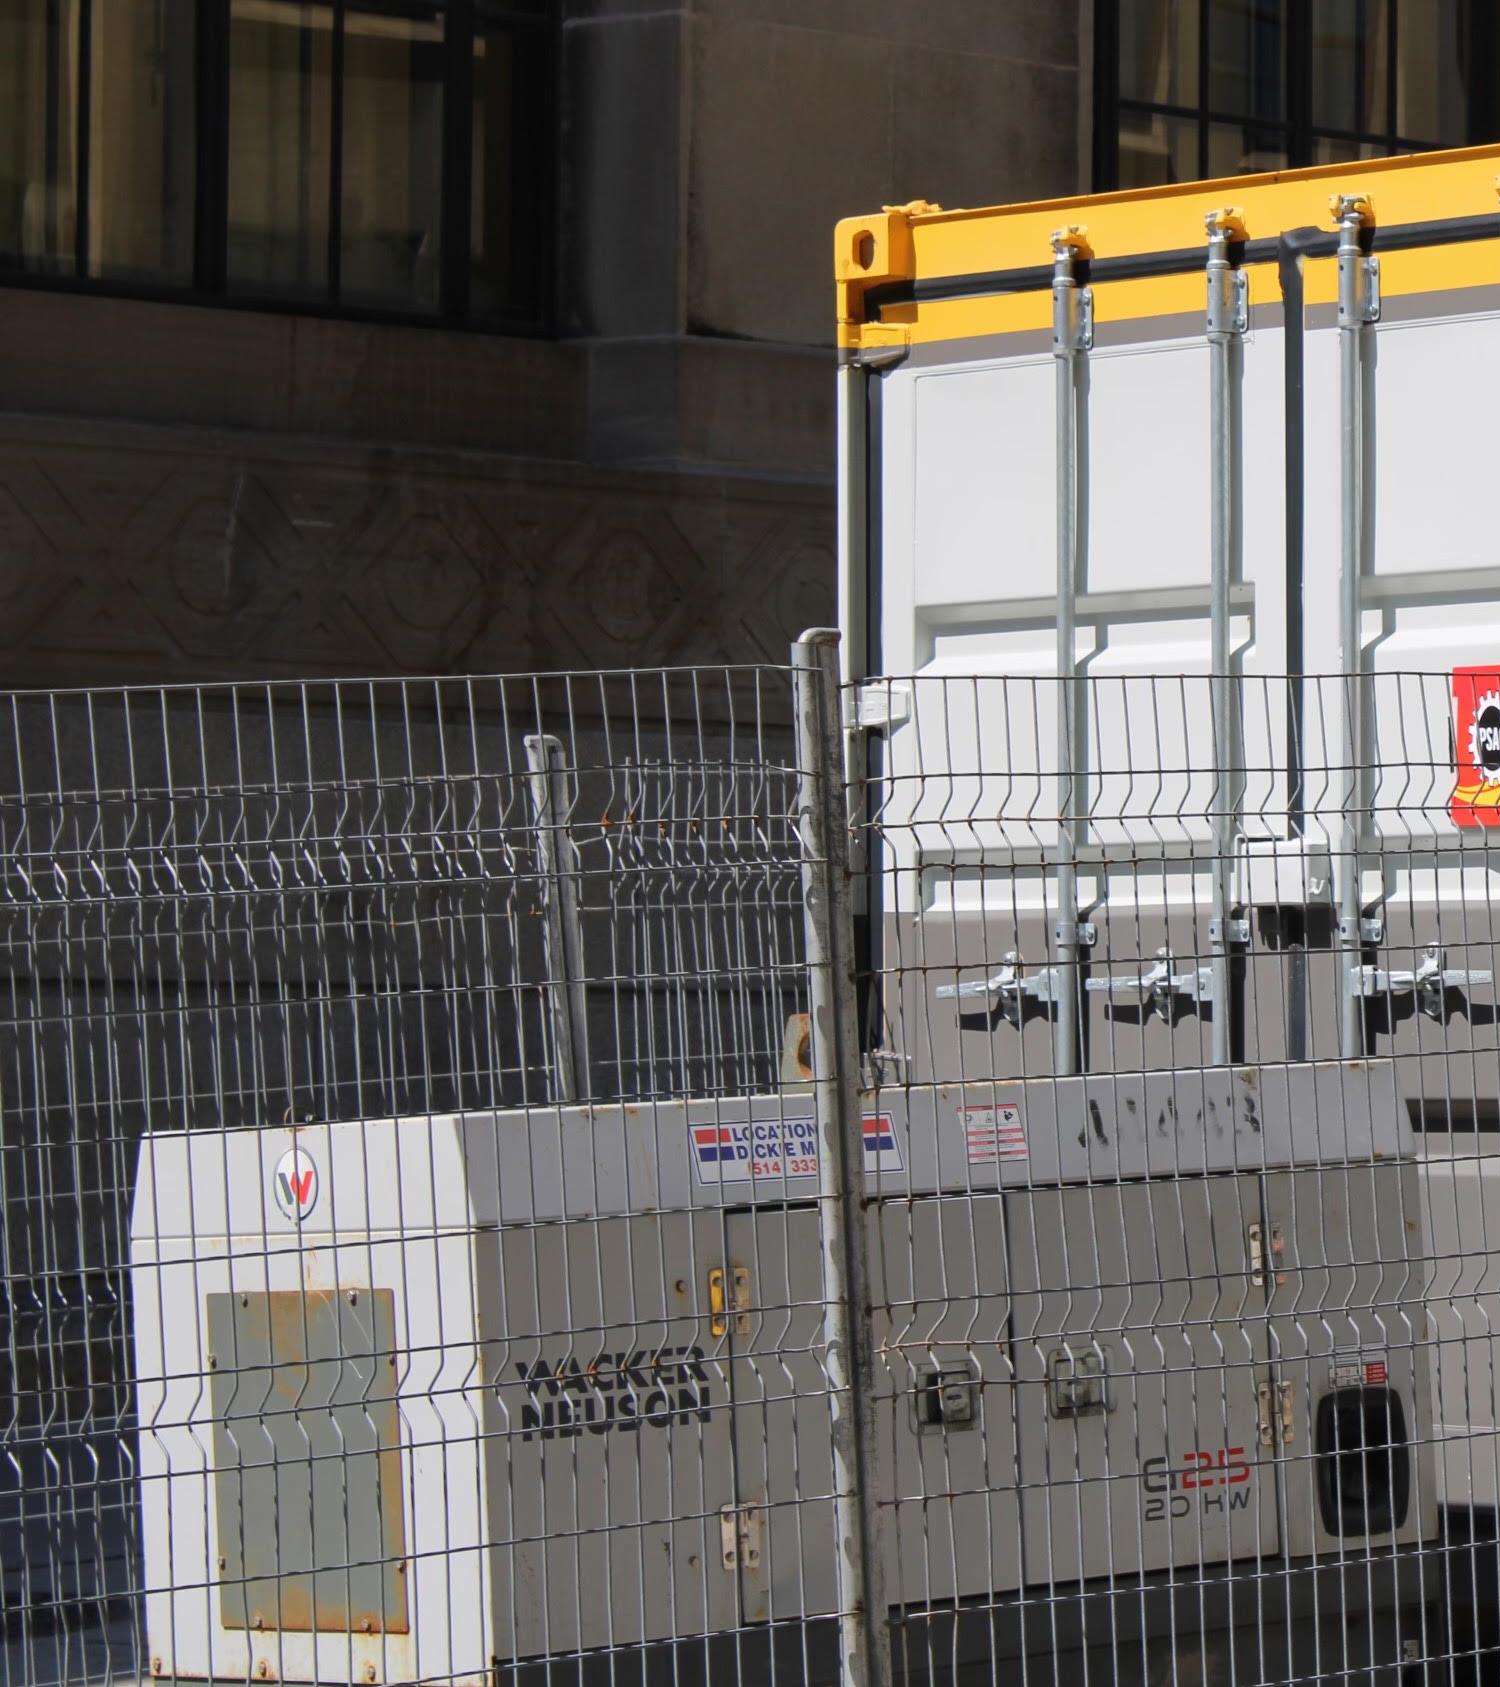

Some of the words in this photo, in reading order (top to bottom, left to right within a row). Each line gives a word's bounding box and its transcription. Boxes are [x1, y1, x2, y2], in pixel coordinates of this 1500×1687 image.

[515, 1346, 709, 1396] WACKER
[521, 1387, 712, 1442] NEUSON
[1143, 1447, 1250, 1493] G25
